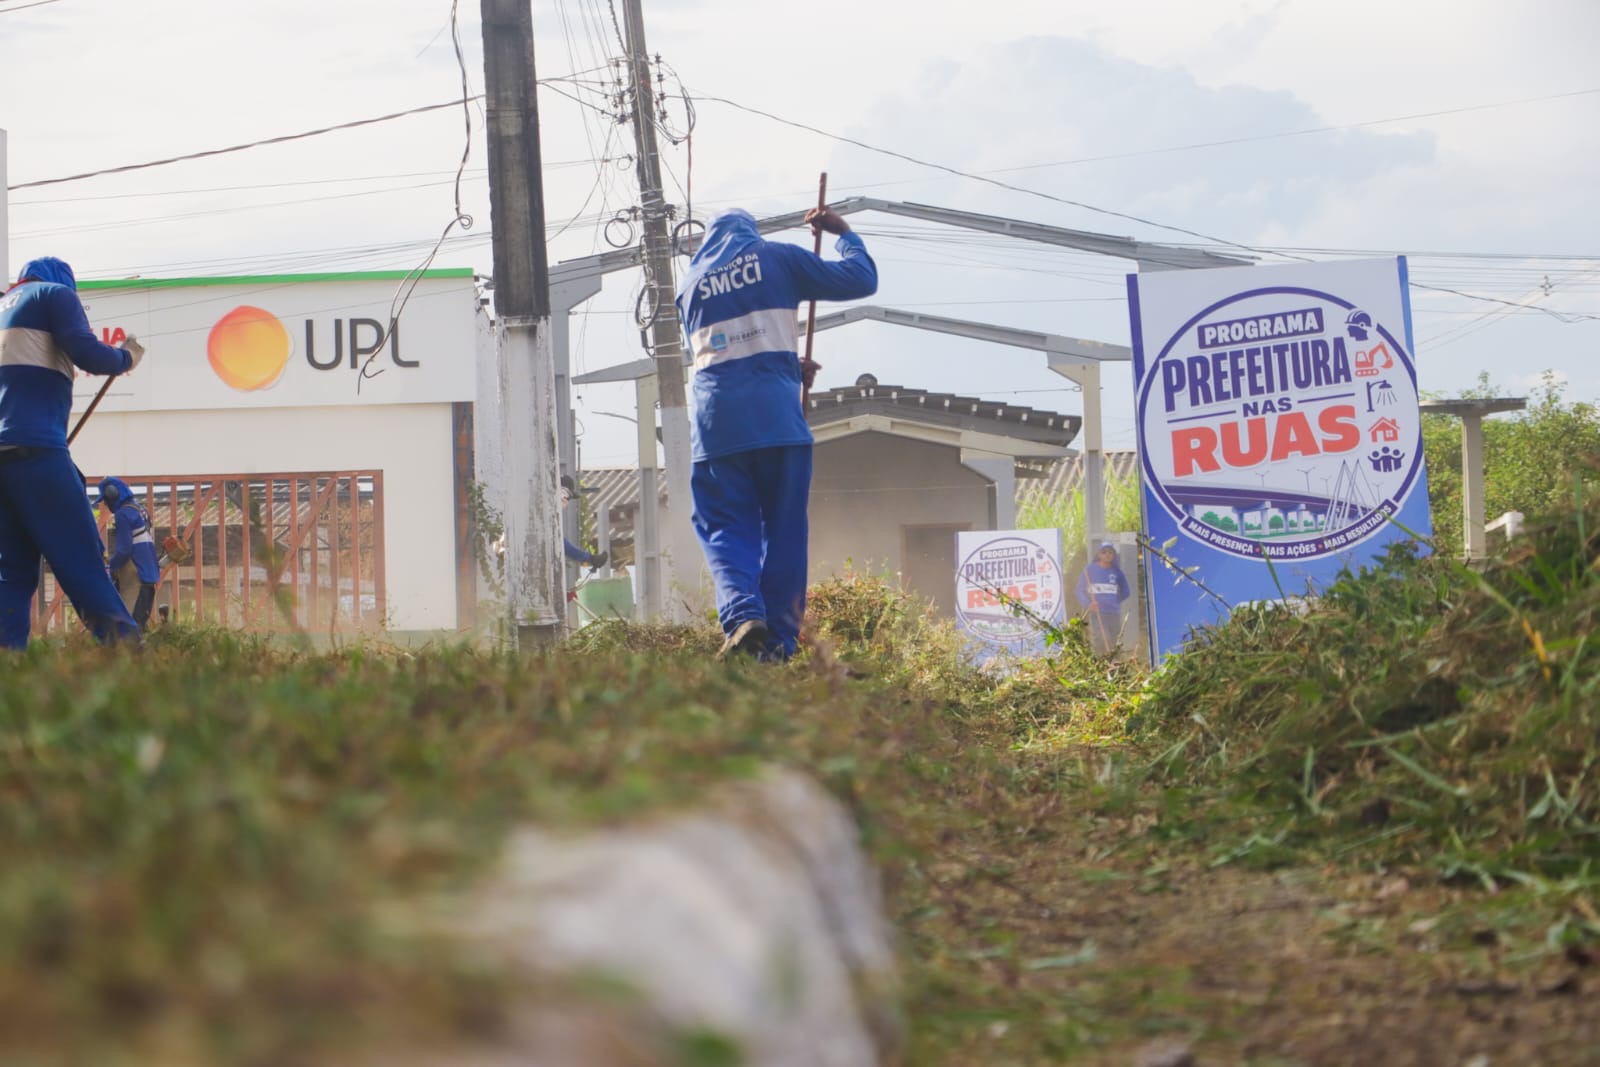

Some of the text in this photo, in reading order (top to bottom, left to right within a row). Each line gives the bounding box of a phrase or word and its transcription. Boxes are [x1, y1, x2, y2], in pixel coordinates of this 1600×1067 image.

[744, 253, 759, 262] DA
[698, 261, 762, 300] SMCCI
[304, 317, 420, 371] UPL
[1204, 311, 1319, 346] PROGRAMA
[1162, 336, 1352, 413] PREFEITURA
[1242, 397, 1293, 417] NAS
[1171, 404, 1361, 478] RUAS
[982, 547, 1026, 559] PROGRAMA
[1188, 520, 1209, 539] MAIS
[1210, 533, 1254, 555] PRESENÇA
[1261, 545, 1285, 556] MAIS
[1287, 543, 1317, 557] AÇÕES
[1323, 536, 1347, 550] MAIS
[965, 557, 1037, 584] PREFEITURA
